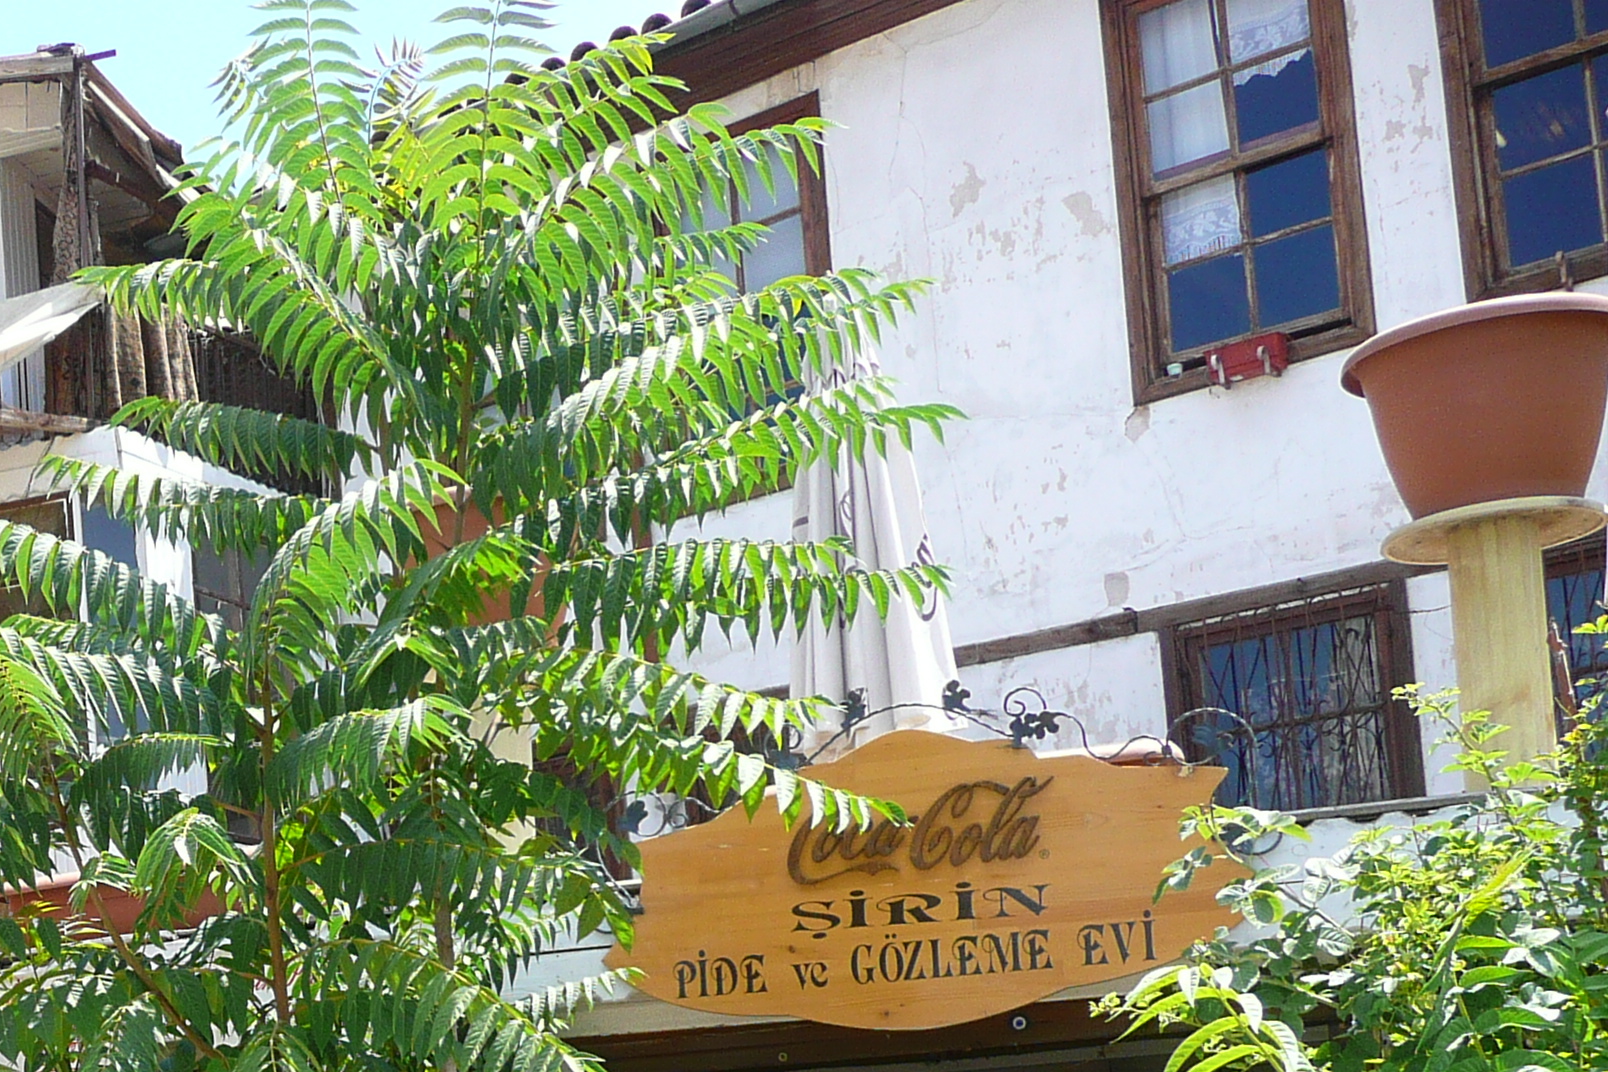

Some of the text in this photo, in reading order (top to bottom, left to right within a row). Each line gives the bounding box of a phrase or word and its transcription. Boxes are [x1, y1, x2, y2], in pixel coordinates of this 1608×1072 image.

[791, 881, 1052, 939] ŞİRİN
[673, 910, 1157, 998] PİDE ve GÖZLEME EVİ
